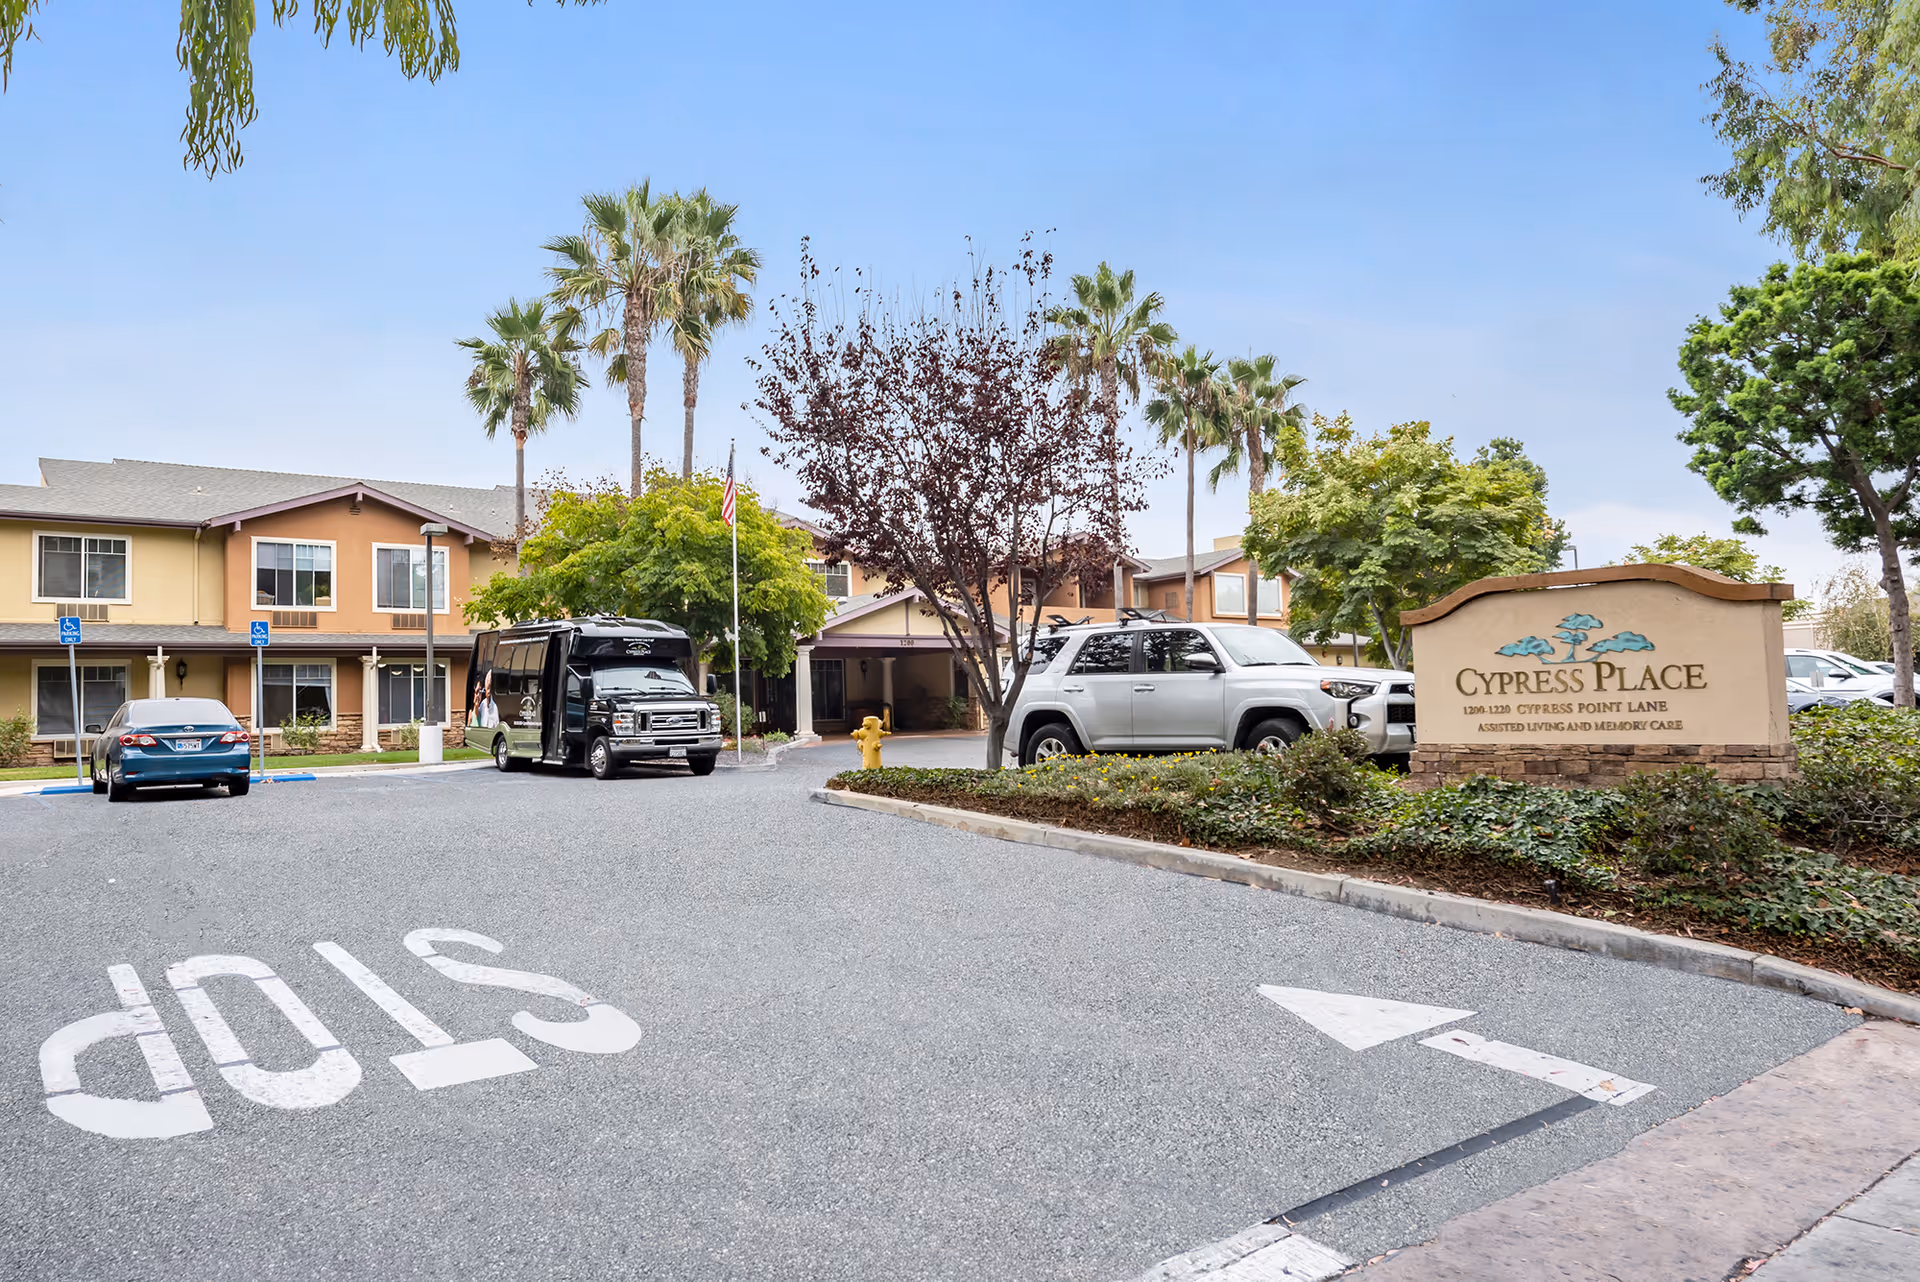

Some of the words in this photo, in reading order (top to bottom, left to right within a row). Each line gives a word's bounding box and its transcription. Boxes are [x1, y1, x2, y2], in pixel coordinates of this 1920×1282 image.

[1455, 667, 1584, 696] CYPRESS
[1593, 661, 1708, 692] PLACE
[1463, 704, 1511, 715] 1200-1220
[1517, 703, 1573, 715] CYPRESS
[1578, 701, 1622, 714] POINT
[1627, 701, 1668, 712] LANE
[1478, 722, 1525, 732] ASSISTED
[1527, 721, 1565, 732] LIVING
[1567, 721, 1592, 732] AND
[1594, 720, 1647, 732] MEMORY
[1650, 720, 1684, 731] CARE
[39, 927, 642, 1140] STOP
